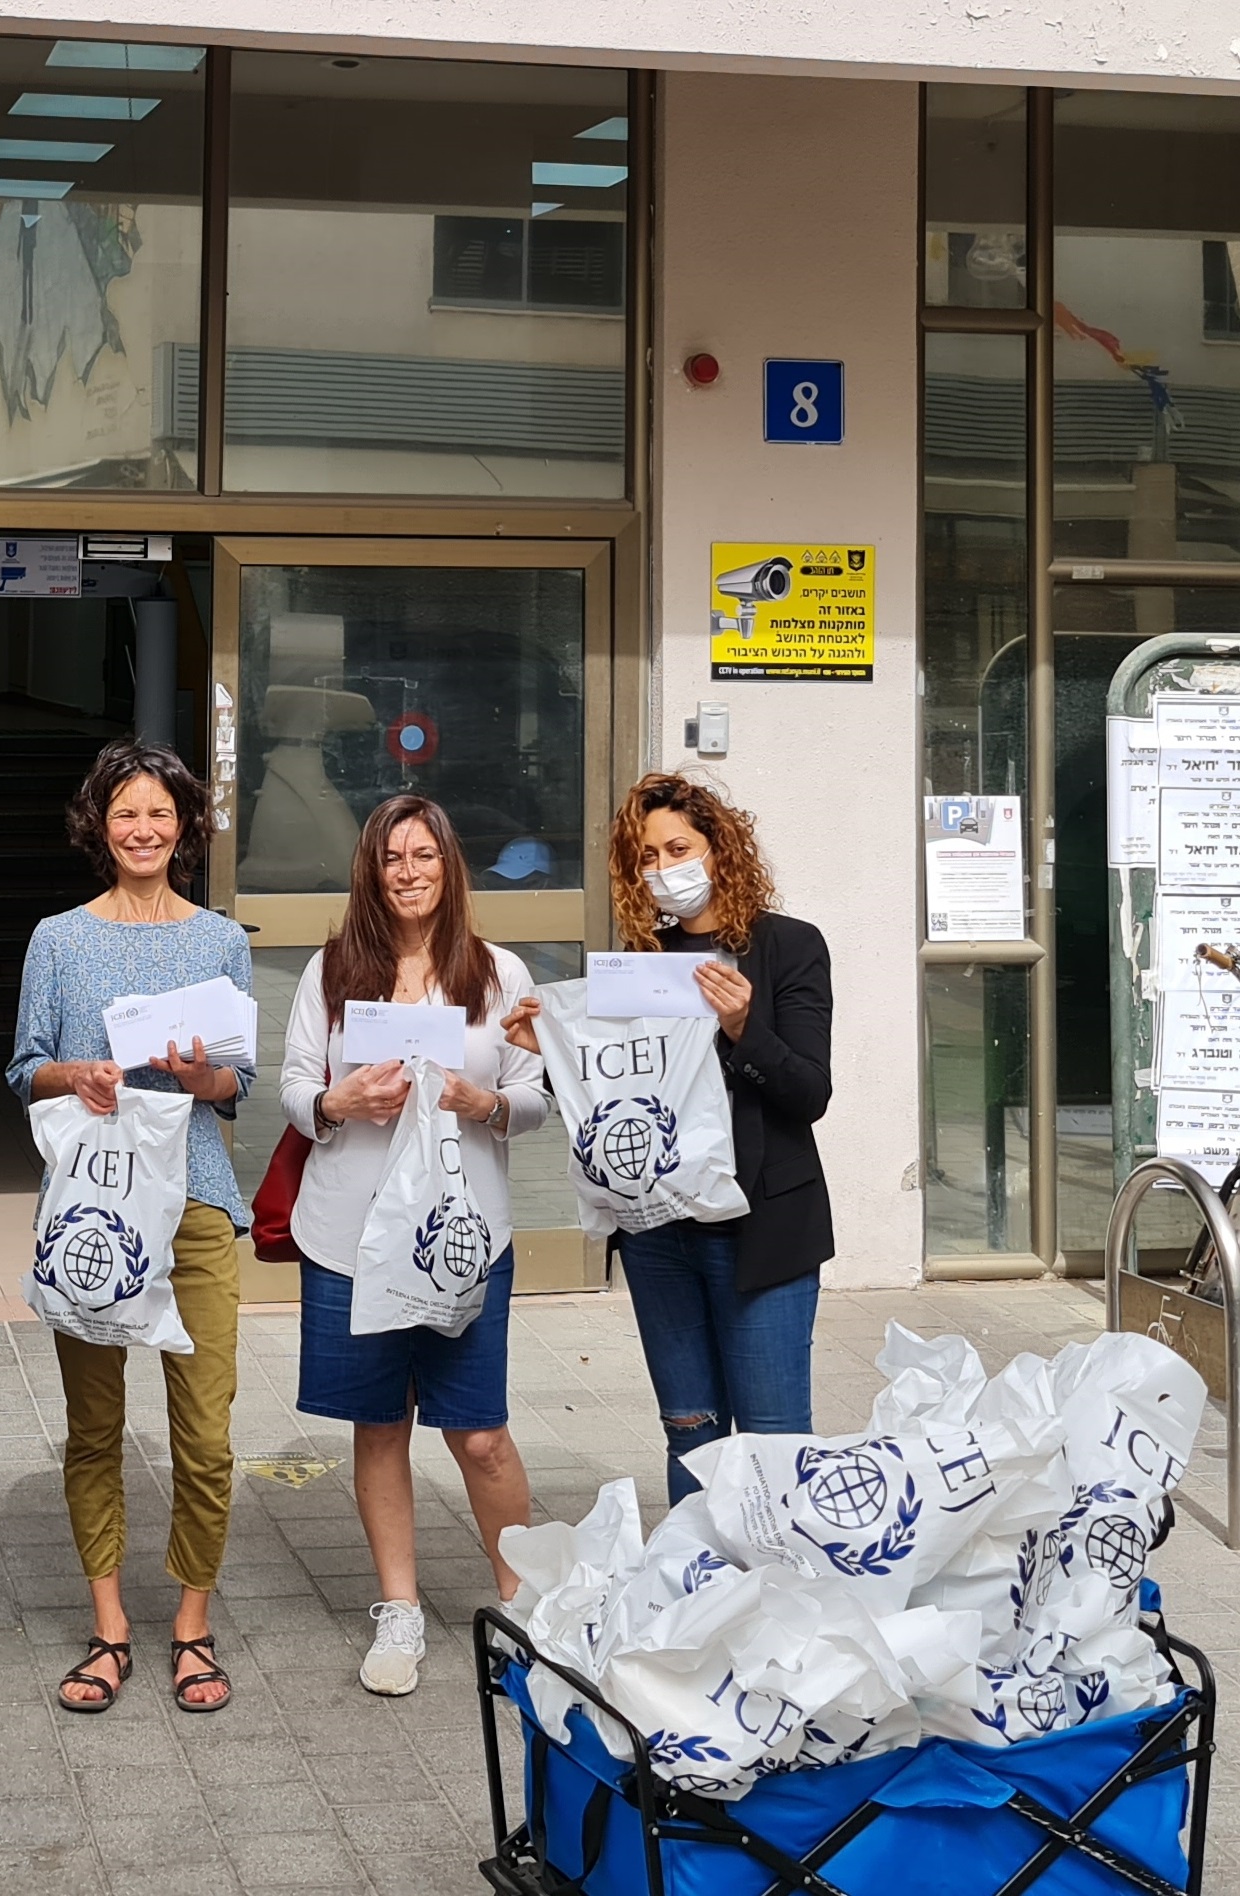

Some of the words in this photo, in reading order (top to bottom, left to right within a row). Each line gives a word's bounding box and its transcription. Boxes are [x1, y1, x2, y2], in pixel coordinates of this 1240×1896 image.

[790, 381, 819, 428] 8
[831, 589, 866, 598] תושבים
[819, 606, 831, 616] זה
[836, 606, 865, 616] באזור
[770, 618, 815, 629] מצלמות
[818, 619, 865, 632] מותקנות
[776, 633, 814, 643] התושב
[818, 633, 865, 644] לאבטחת
[727, 647, 768, 657] הציבורי
[772, 648, 806, 657] הרכוש
[810, 647, 824, 658] על
[828, 648, 865, 658] ולהגנה
[1182, 759, 1219, 771] יחיאל
[948, 806, 962, 825] P
[1185, 844, 1218, 855] יחיאל
[576, 1035, 669, 1083] ICEJ
[1100, 1405, 1186, 1491] ICE
[705, 1667, 803, 1748] ICE
